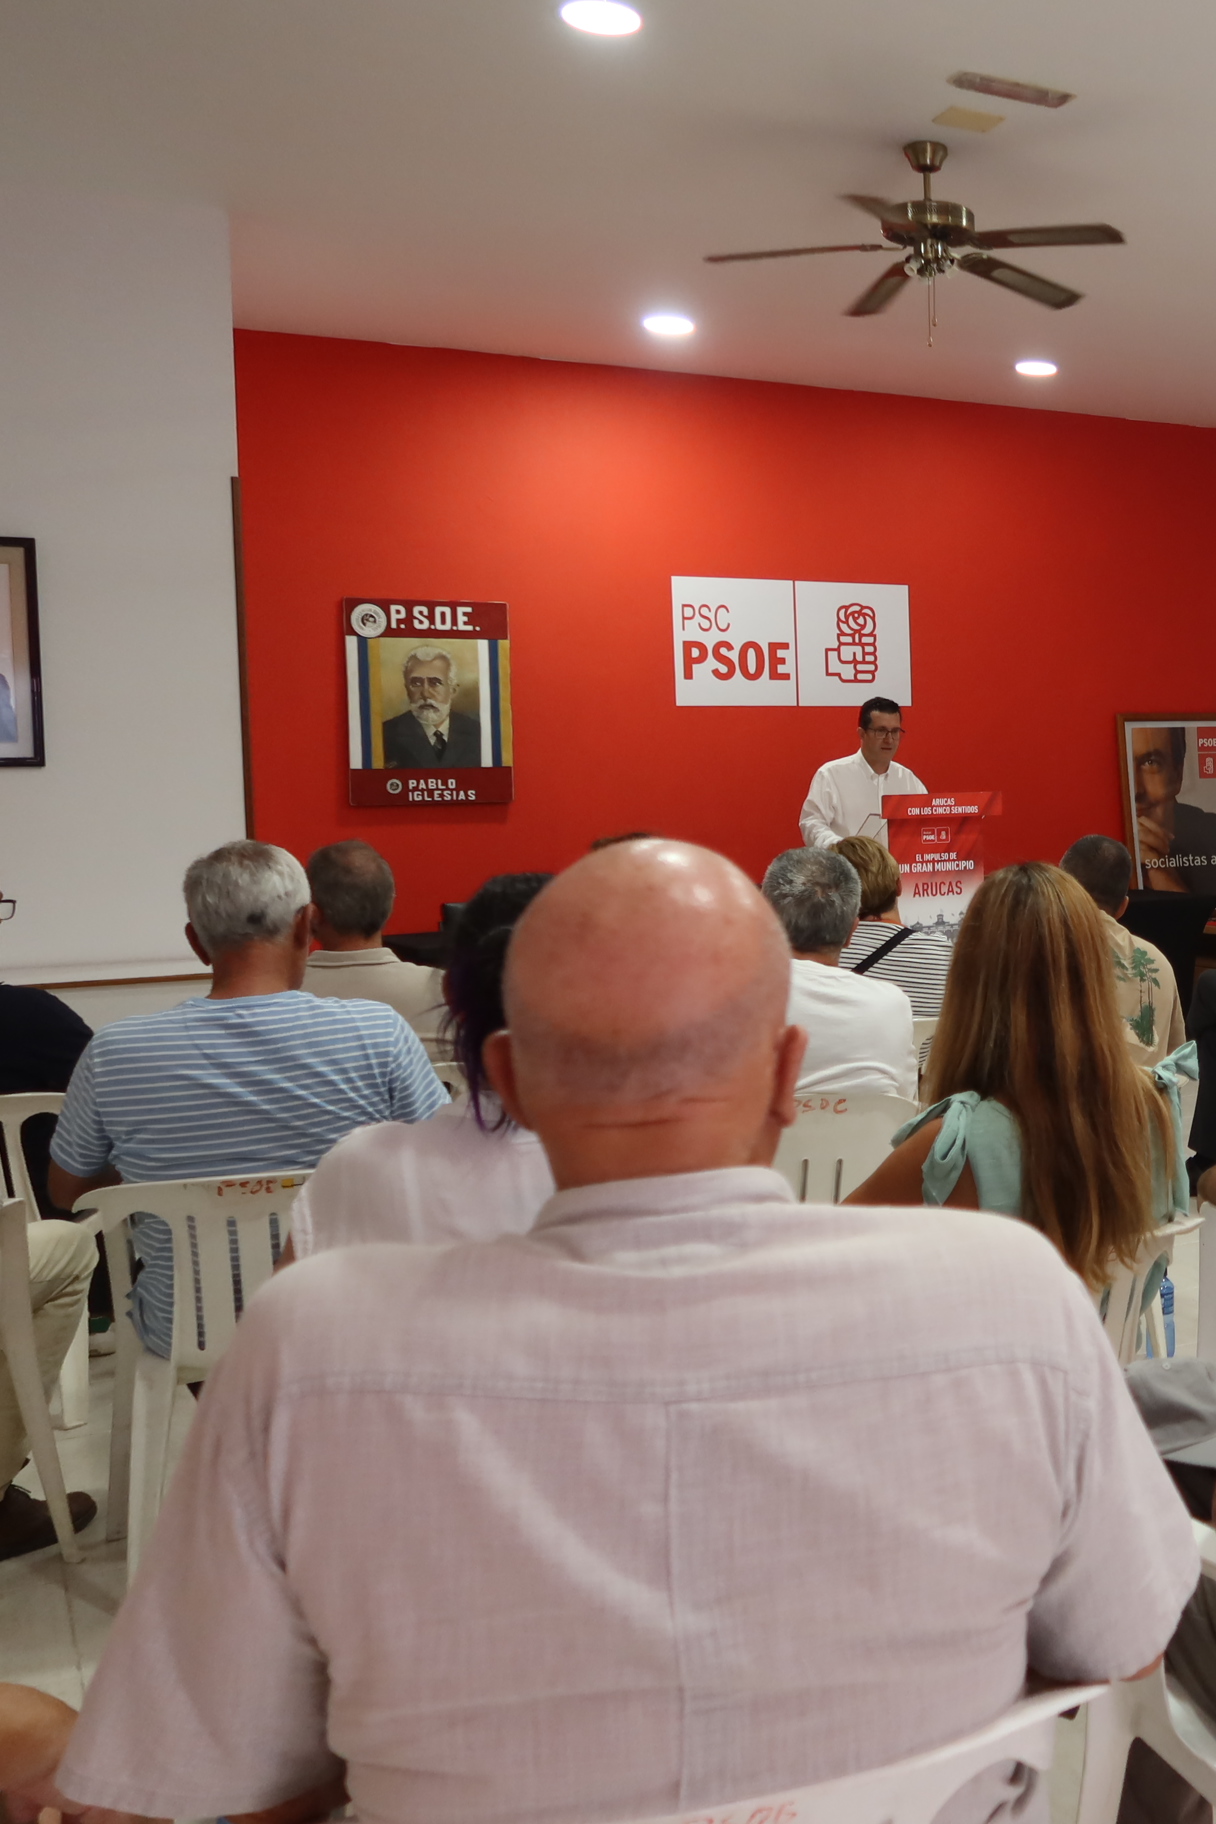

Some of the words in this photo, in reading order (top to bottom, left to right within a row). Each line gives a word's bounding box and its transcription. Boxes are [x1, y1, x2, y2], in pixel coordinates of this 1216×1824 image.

[681, 603, 731, 633] PSC
[682, 640, 791, 681] PSOE
[408, 779, 457, 790] PABLO
[408, 790, 477, 801] IGLESIAS
[931, 797, 955, 806] ARUCAS
[907, 807, 920, 816] CON
[920, 806, 932, 815] LOS
[932, 806, 951, 815] CINCO
[951, 805, 979, 814] SENTIDOS
[915, 853, 923, 862] EL
[923, 852, 949, 861] IMPULSO
[949, 852, 957, 860] DE
[1145, 853, 1208, 870] socialistas
[899, 863, 910, 874] UN
[911, 862, 933, 873] GRAN
[934, 860, 975, 872] MUNICIPIO
[913, 880, 963, 898] ARUCAS
